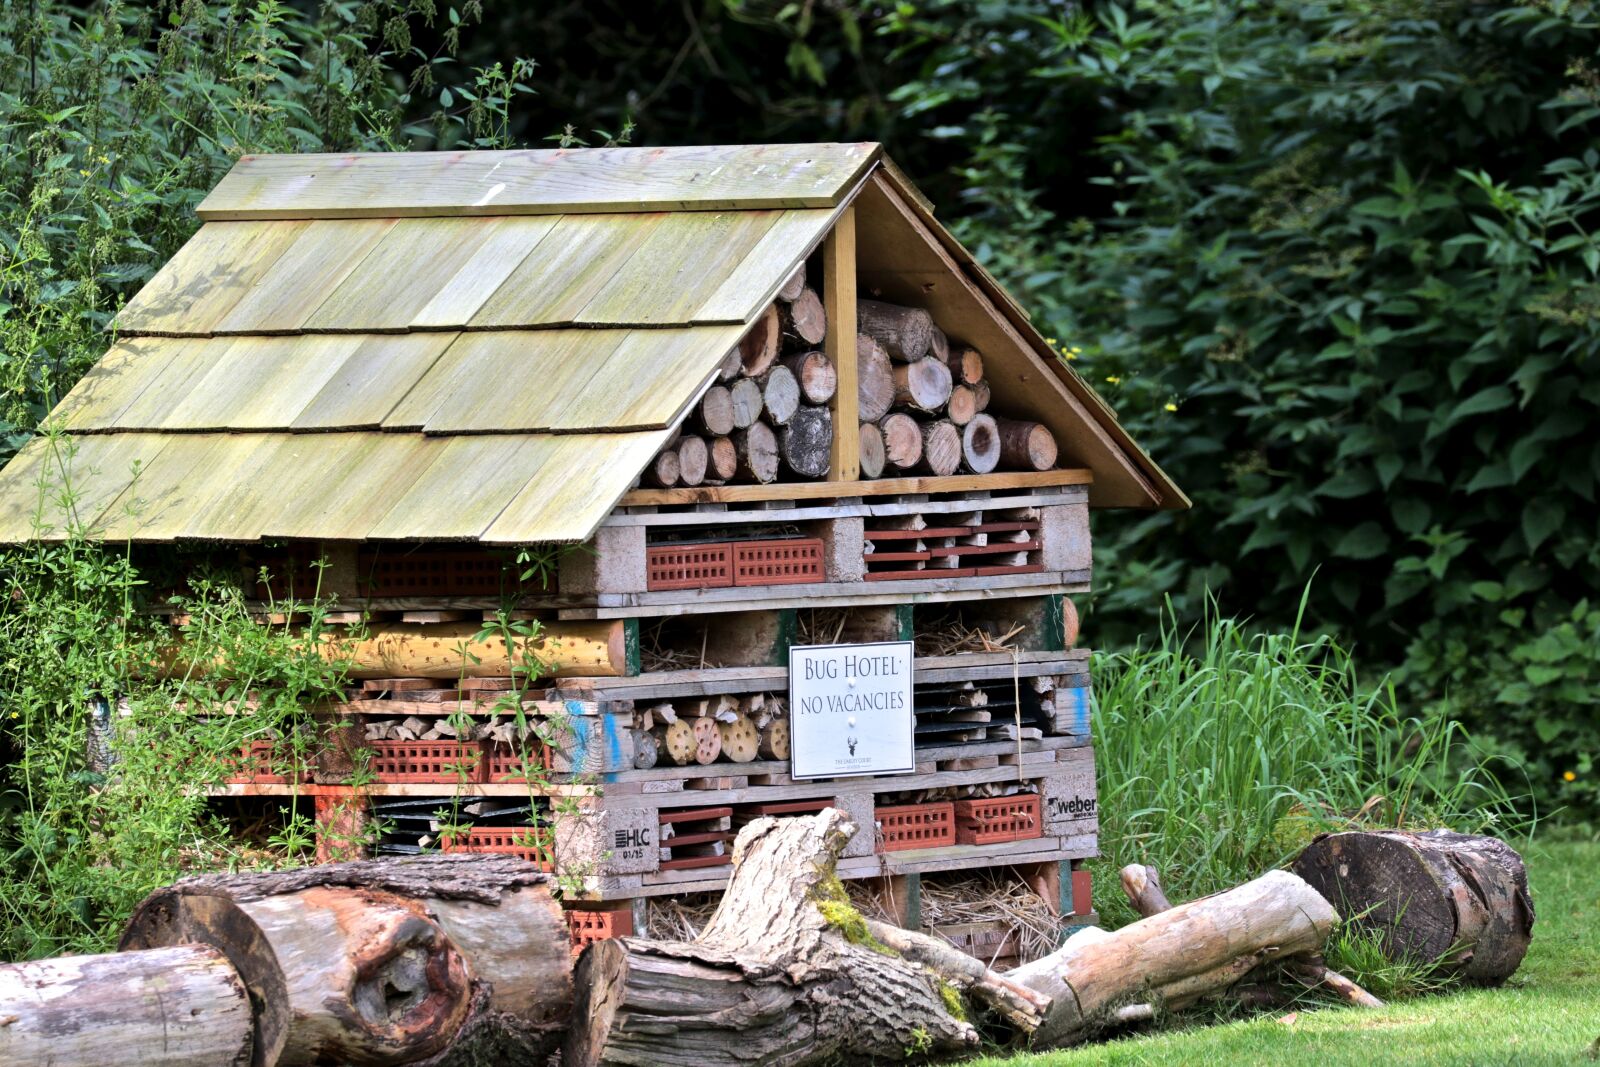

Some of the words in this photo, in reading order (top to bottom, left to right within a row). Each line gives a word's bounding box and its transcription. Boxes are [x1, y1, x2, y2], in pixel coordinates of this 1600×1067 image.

[801, 696, 823, 714] NO
[826, 691, 904, 713] VACANCIES
[1058, 795, 1097, 814] weber
[626, 828, 650, 847] HLC
